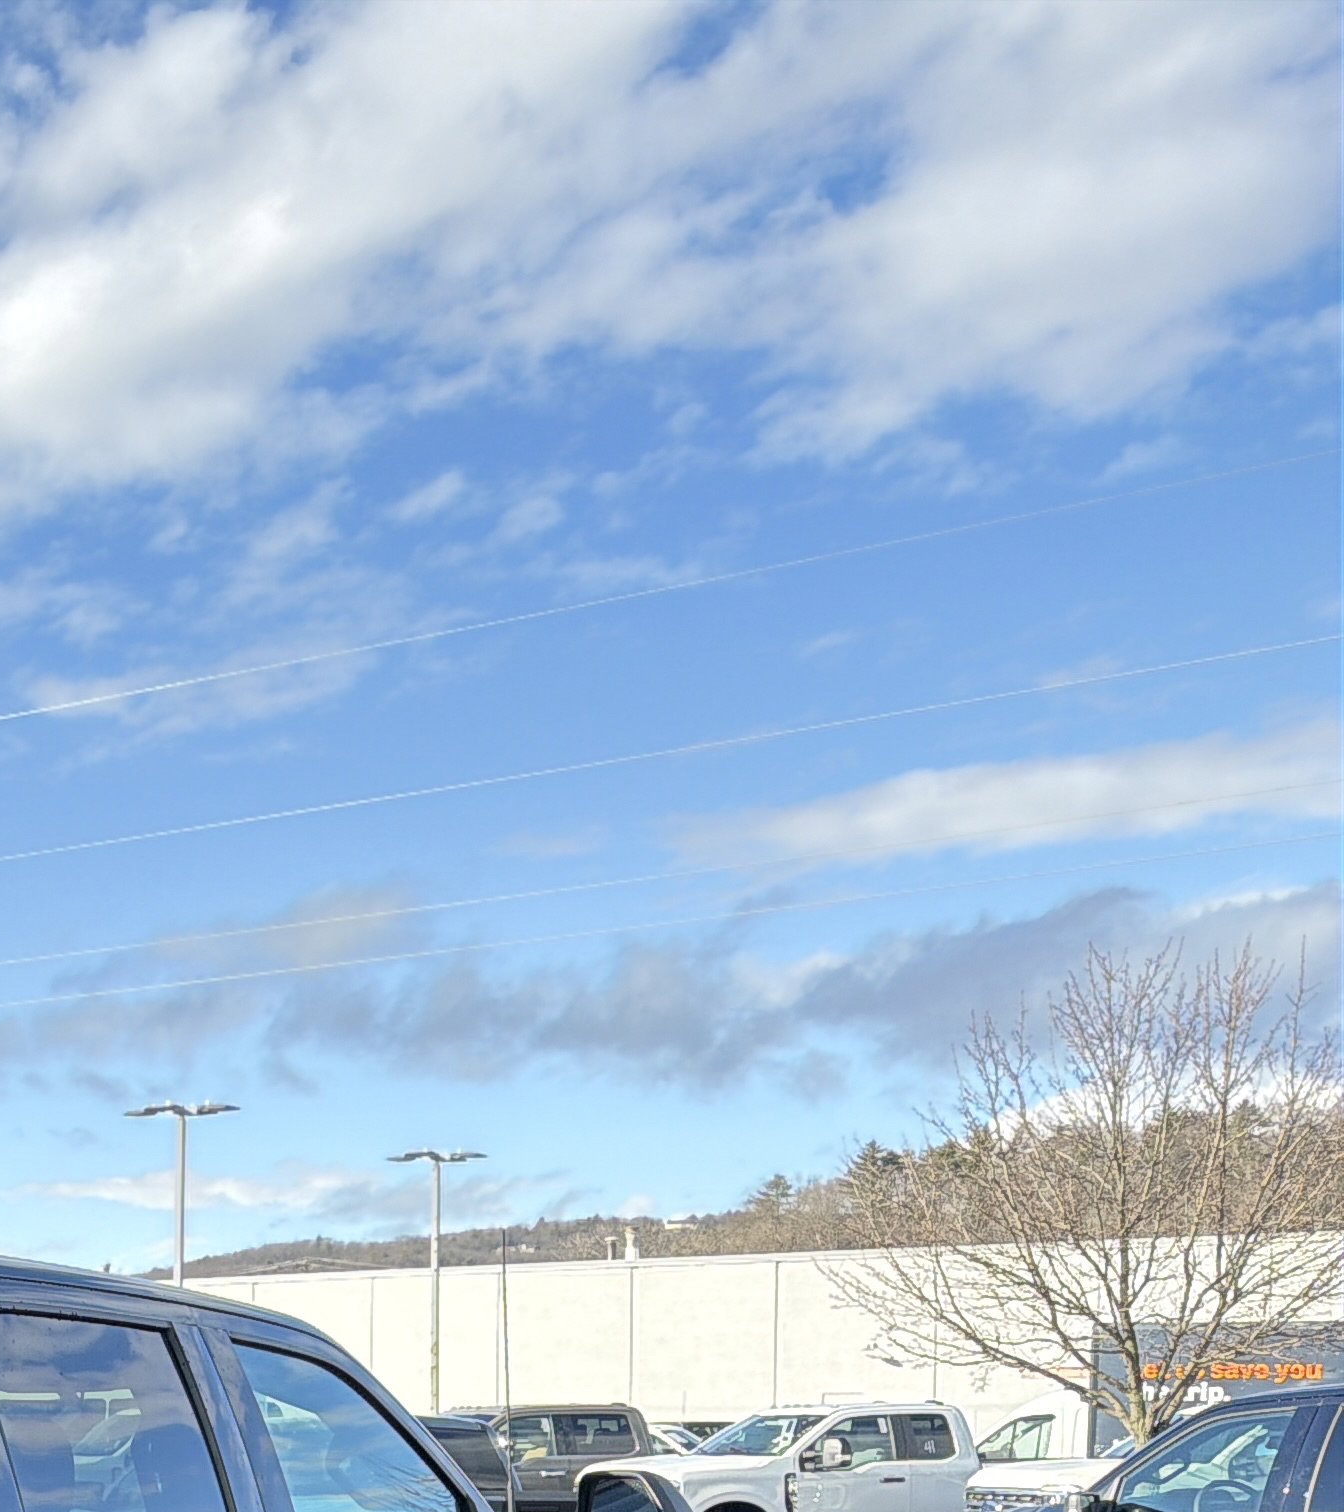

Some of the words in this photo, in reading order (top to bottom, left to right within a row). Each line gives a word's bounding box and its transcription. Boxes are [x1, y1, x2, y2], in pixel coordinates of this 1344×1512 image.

[1210, 1361, 1270, 1380] save
[1273, 1362, 1324, 1384] you
[924, 1439, 936, 1454] 41
